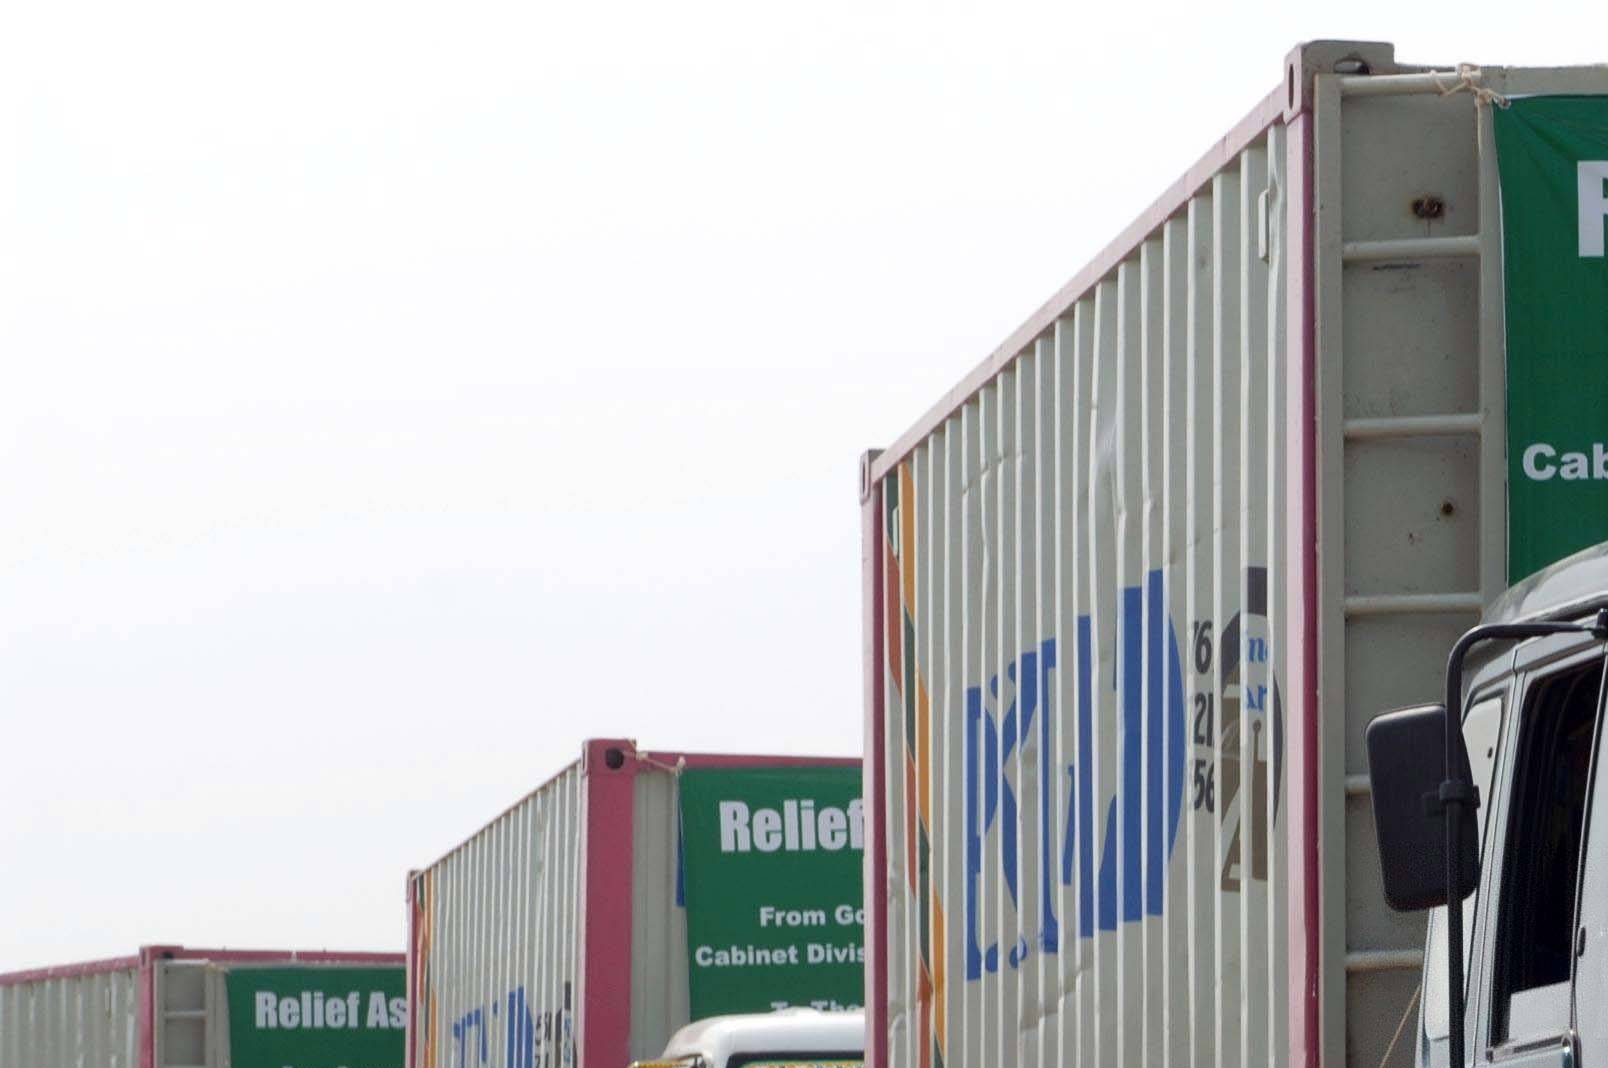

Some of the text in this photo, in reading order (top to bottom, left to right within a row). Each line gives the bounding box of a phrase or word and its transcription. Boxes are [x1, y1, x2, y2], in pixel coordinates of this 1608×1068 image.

[760, 906, 826, 927] From
[695, 945, 799, 967] Cabinet
[255, 991, 360, 1028] Relief
